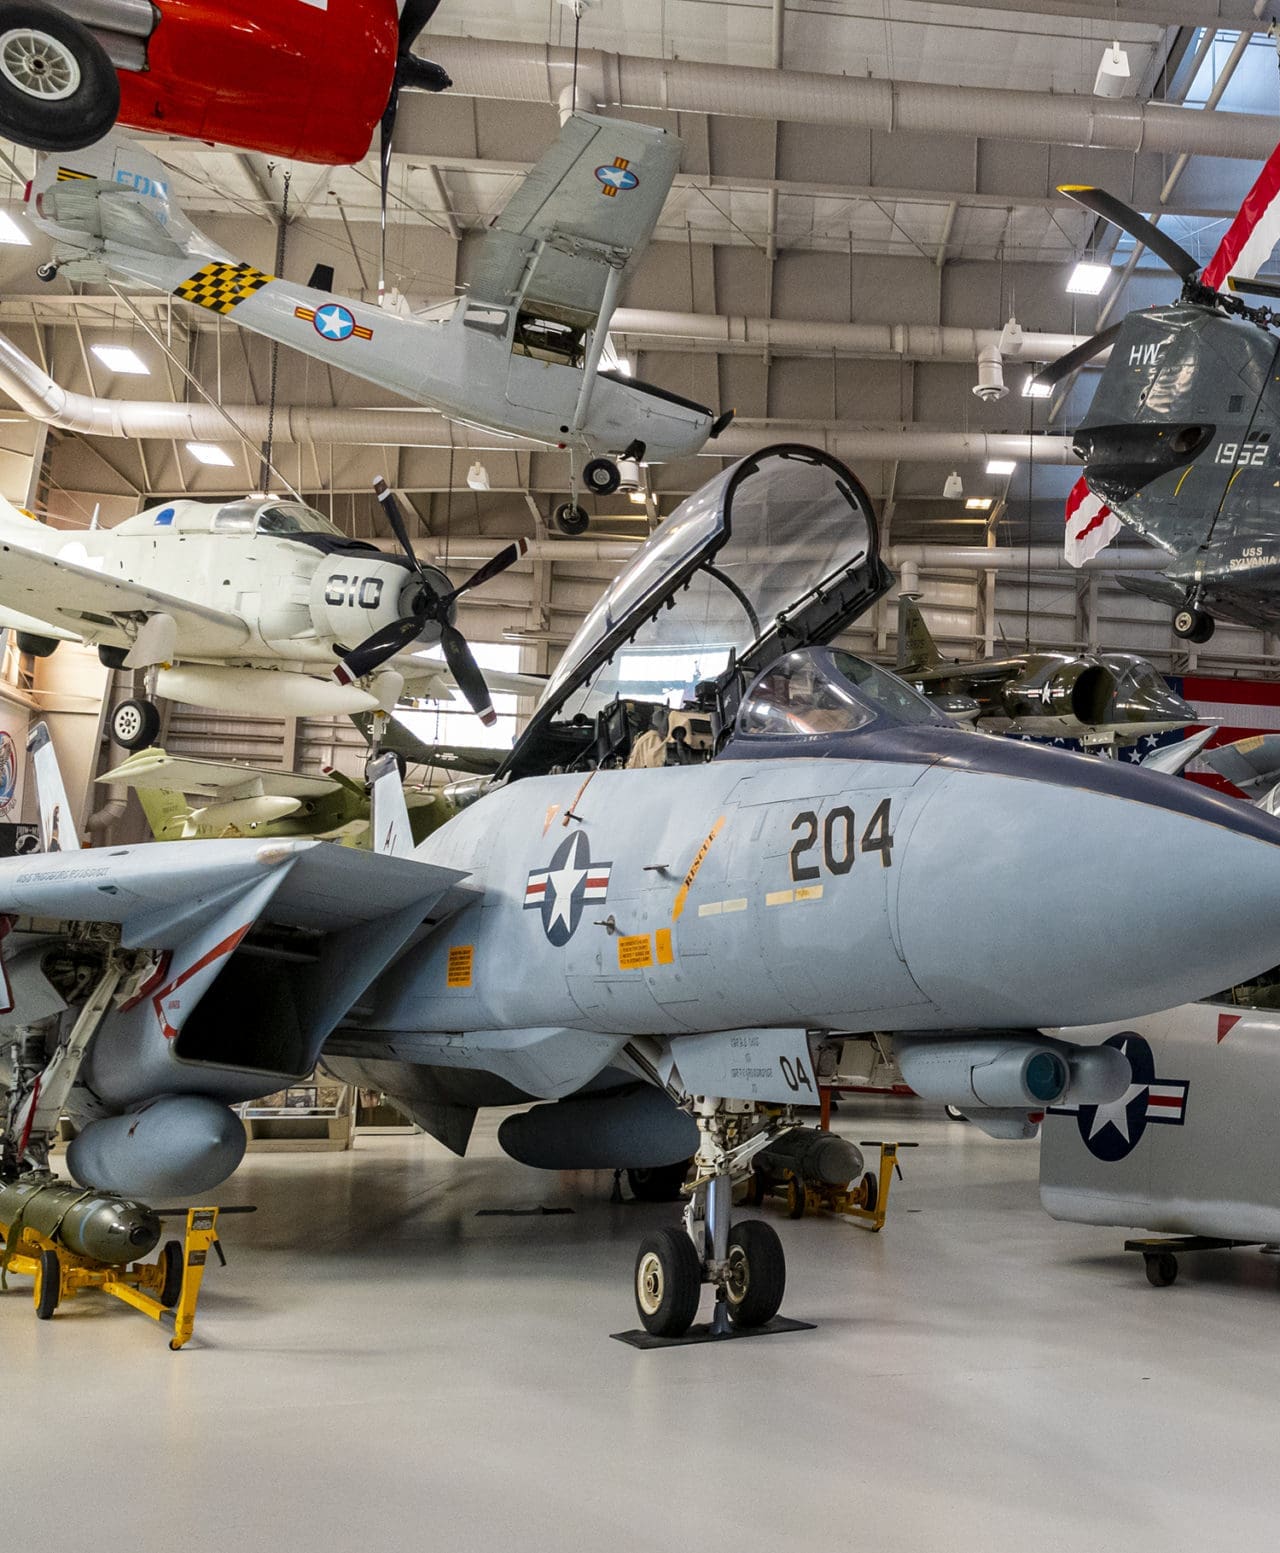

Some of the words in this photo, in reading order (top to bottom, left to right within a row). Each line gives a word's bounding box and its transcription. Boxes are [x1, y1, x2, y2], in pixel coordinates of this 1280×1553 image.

[1214, 443, 1269, 465] 1952
[1242, 546, 1263, 557] USS
[325, 574, 384, 609] 610
[789, 797, 894, 882] 204
[685, 830, 715, 887] RESCUE
[780, 1056, 813, 1092] 04
